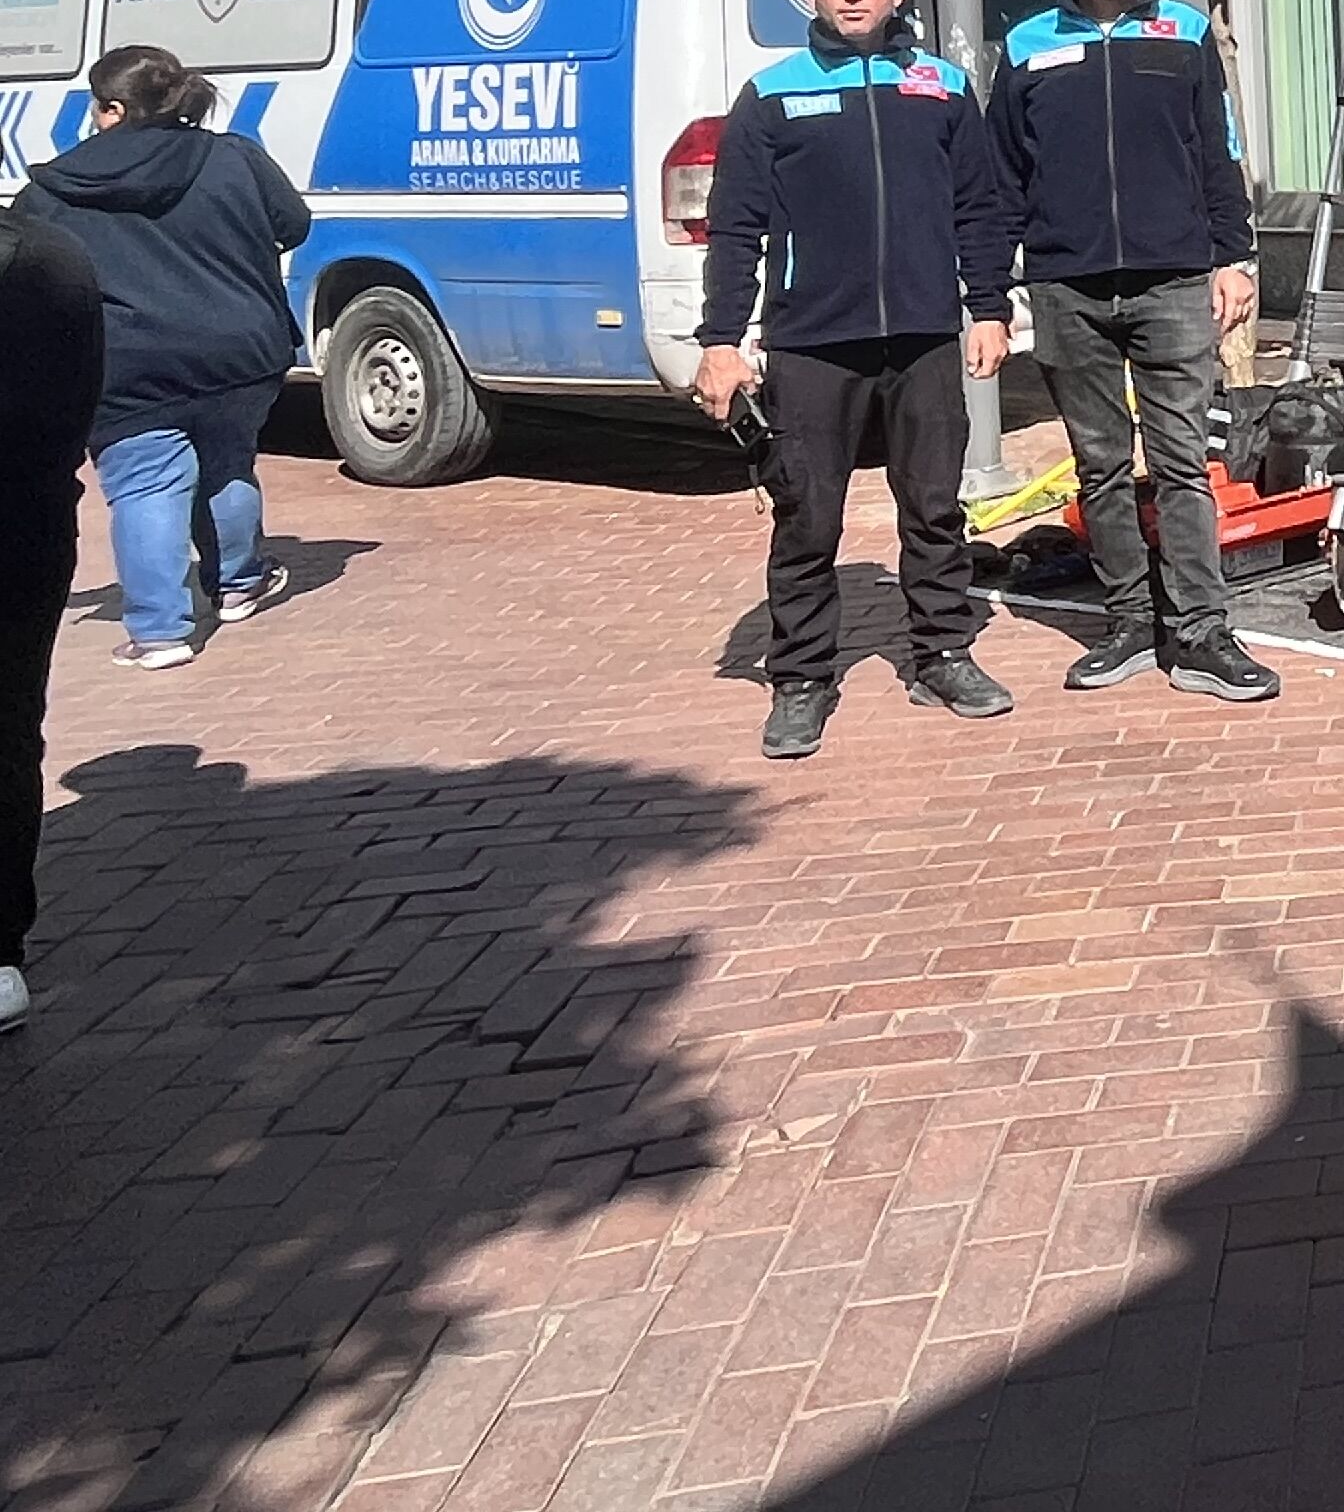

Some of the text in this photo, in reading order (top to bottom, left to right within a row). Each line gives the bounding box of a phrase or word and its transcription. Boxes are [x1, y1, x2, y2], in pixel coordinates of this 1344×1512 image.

[412, 51, 581, 133] YESEVİ
[410, 136, 580, 167] ARAMA & KURTARMA
[408, 169, 582, 192] SEARCH&RESCUE
